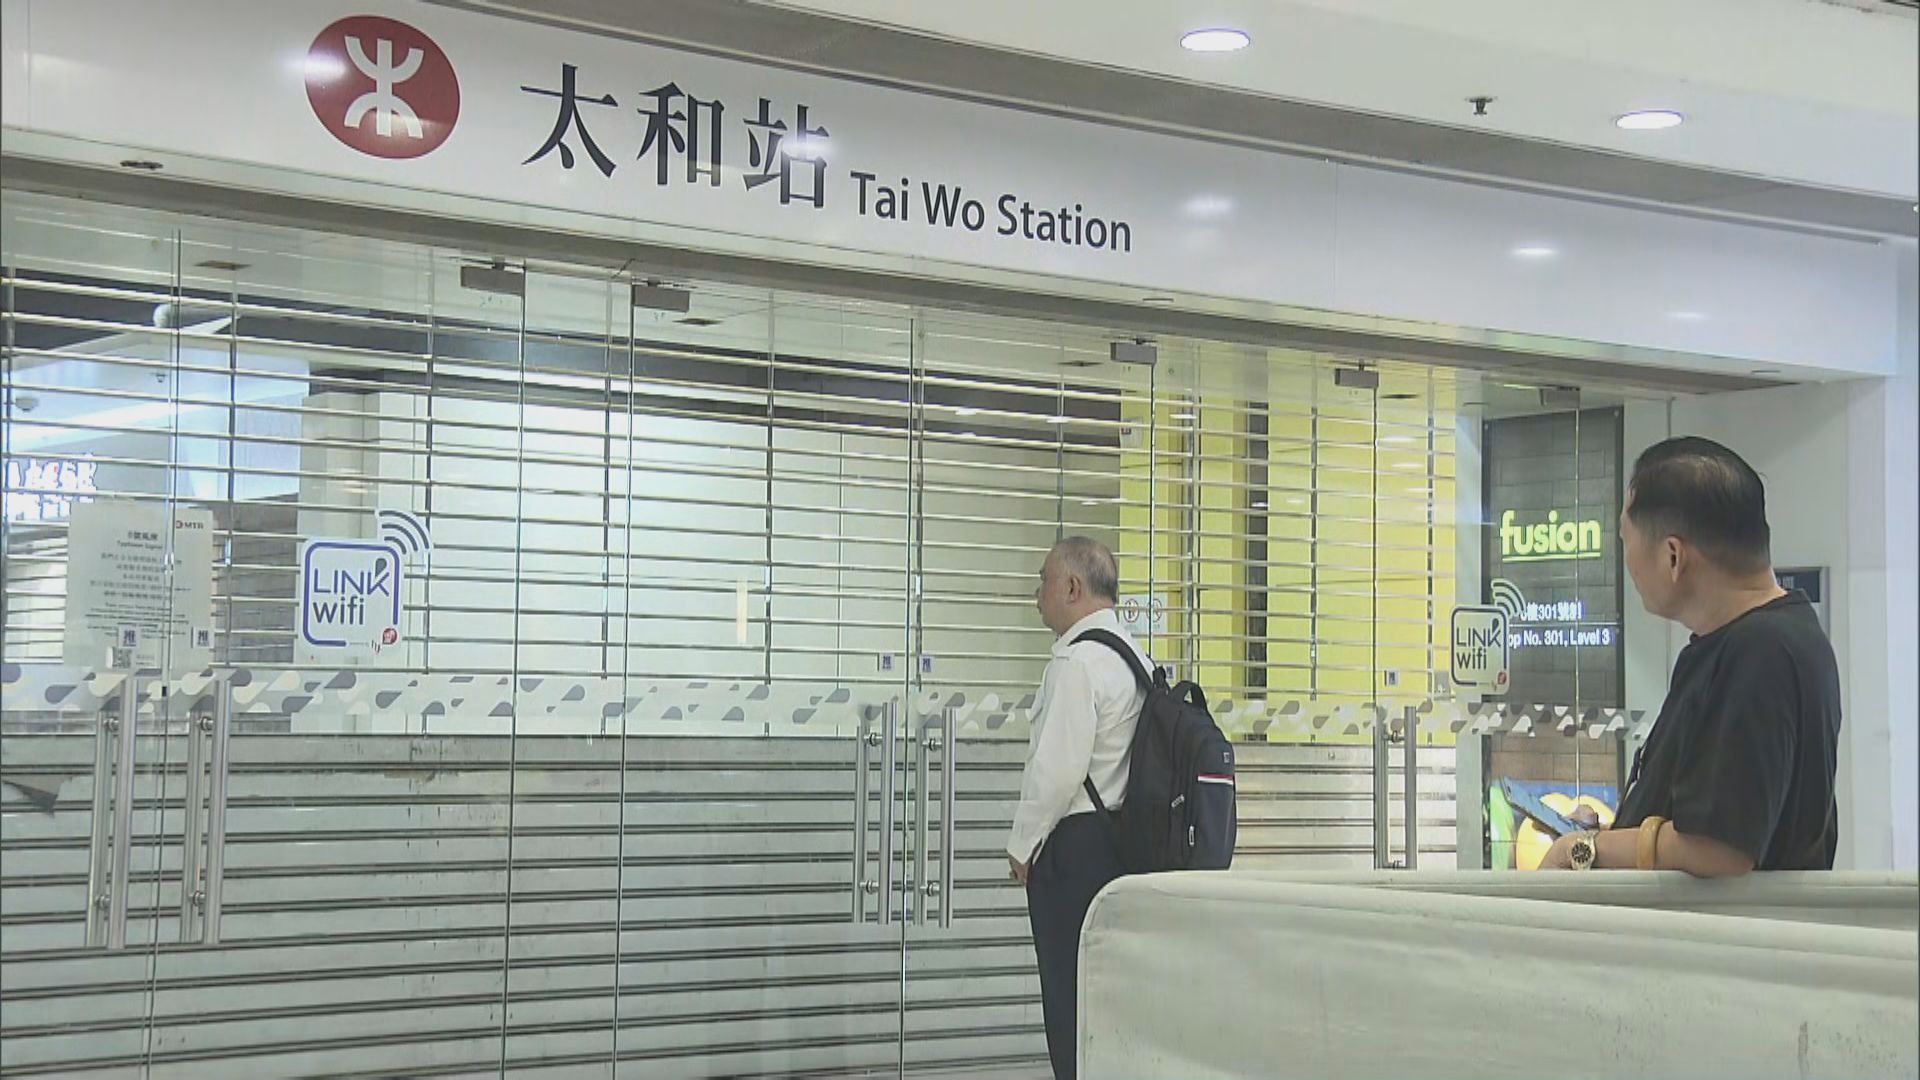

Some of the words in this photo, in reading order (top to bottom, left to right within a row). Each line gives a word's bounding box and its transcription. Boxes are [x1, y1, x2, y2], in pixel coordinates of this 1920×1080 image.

[520, 62, 831, 210] 太和站
[850, 170, 911, 221] Tai
[923, 181, 987, 232] Wo
[997, 194, 1132, 253] Station
[1500, 510, 1601, 555] fusion
[313, 563, 391, 597] LINK
[312, 595, 365, 625] wifi
[1456, 624, 1501, 648] LINK
[1508, 633, 1521, 649] op
[1523, 630, 1543, 646] No.
[1544, 629, 1569, 648] 301,
[1570, 627, 1600, 646] Level
[1601, 627, 1611, 646] 3
[1456, 647, 1487, 670] wifi
